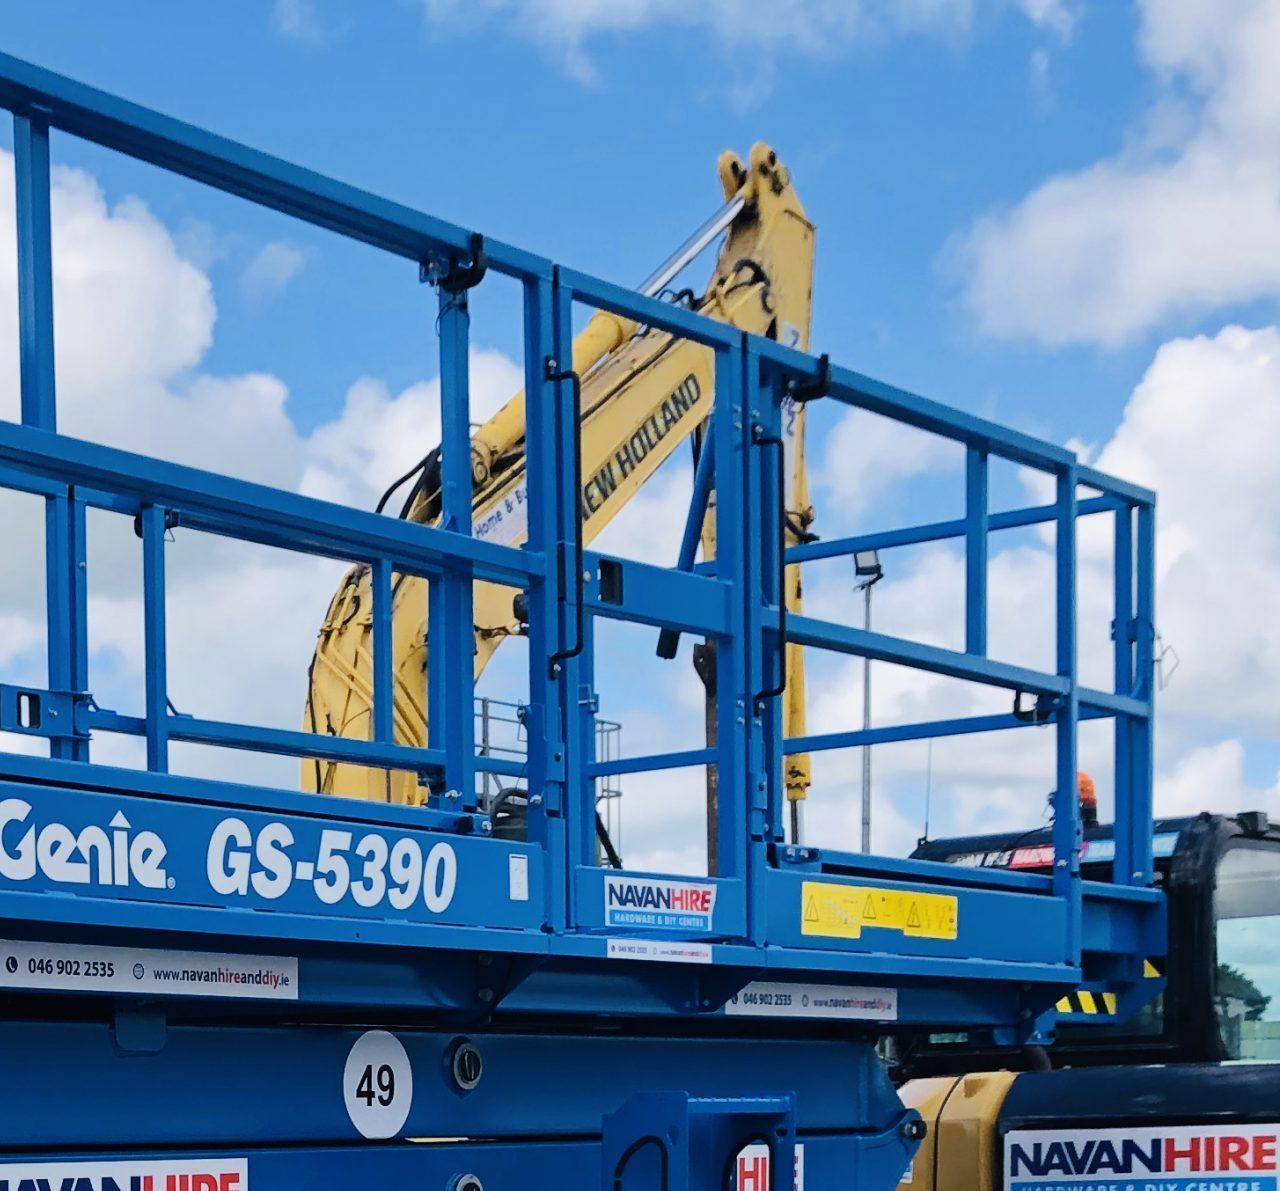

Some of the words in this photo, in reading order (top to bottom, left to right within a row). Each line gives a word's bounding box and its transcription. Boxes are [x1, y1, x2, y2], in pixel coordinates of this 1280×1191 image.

[615, 372, 701, 480] HOLLAND
[474, 510, 503, 538] Home
[205, 816, 457, 914] GS-5390
[608, 883, 712, 912] NAVANHIRE
[28, 957, 53, 975] 046
[57, 959, 81, 976] 902
[84, 961, 114, 977] 2535
[153, 967, 290, 989] www.navanhireanddiy.ie
[355, 1063, 396, 1107] 49
[1010, 1135, 1277, 1177] NAVANHIRE
